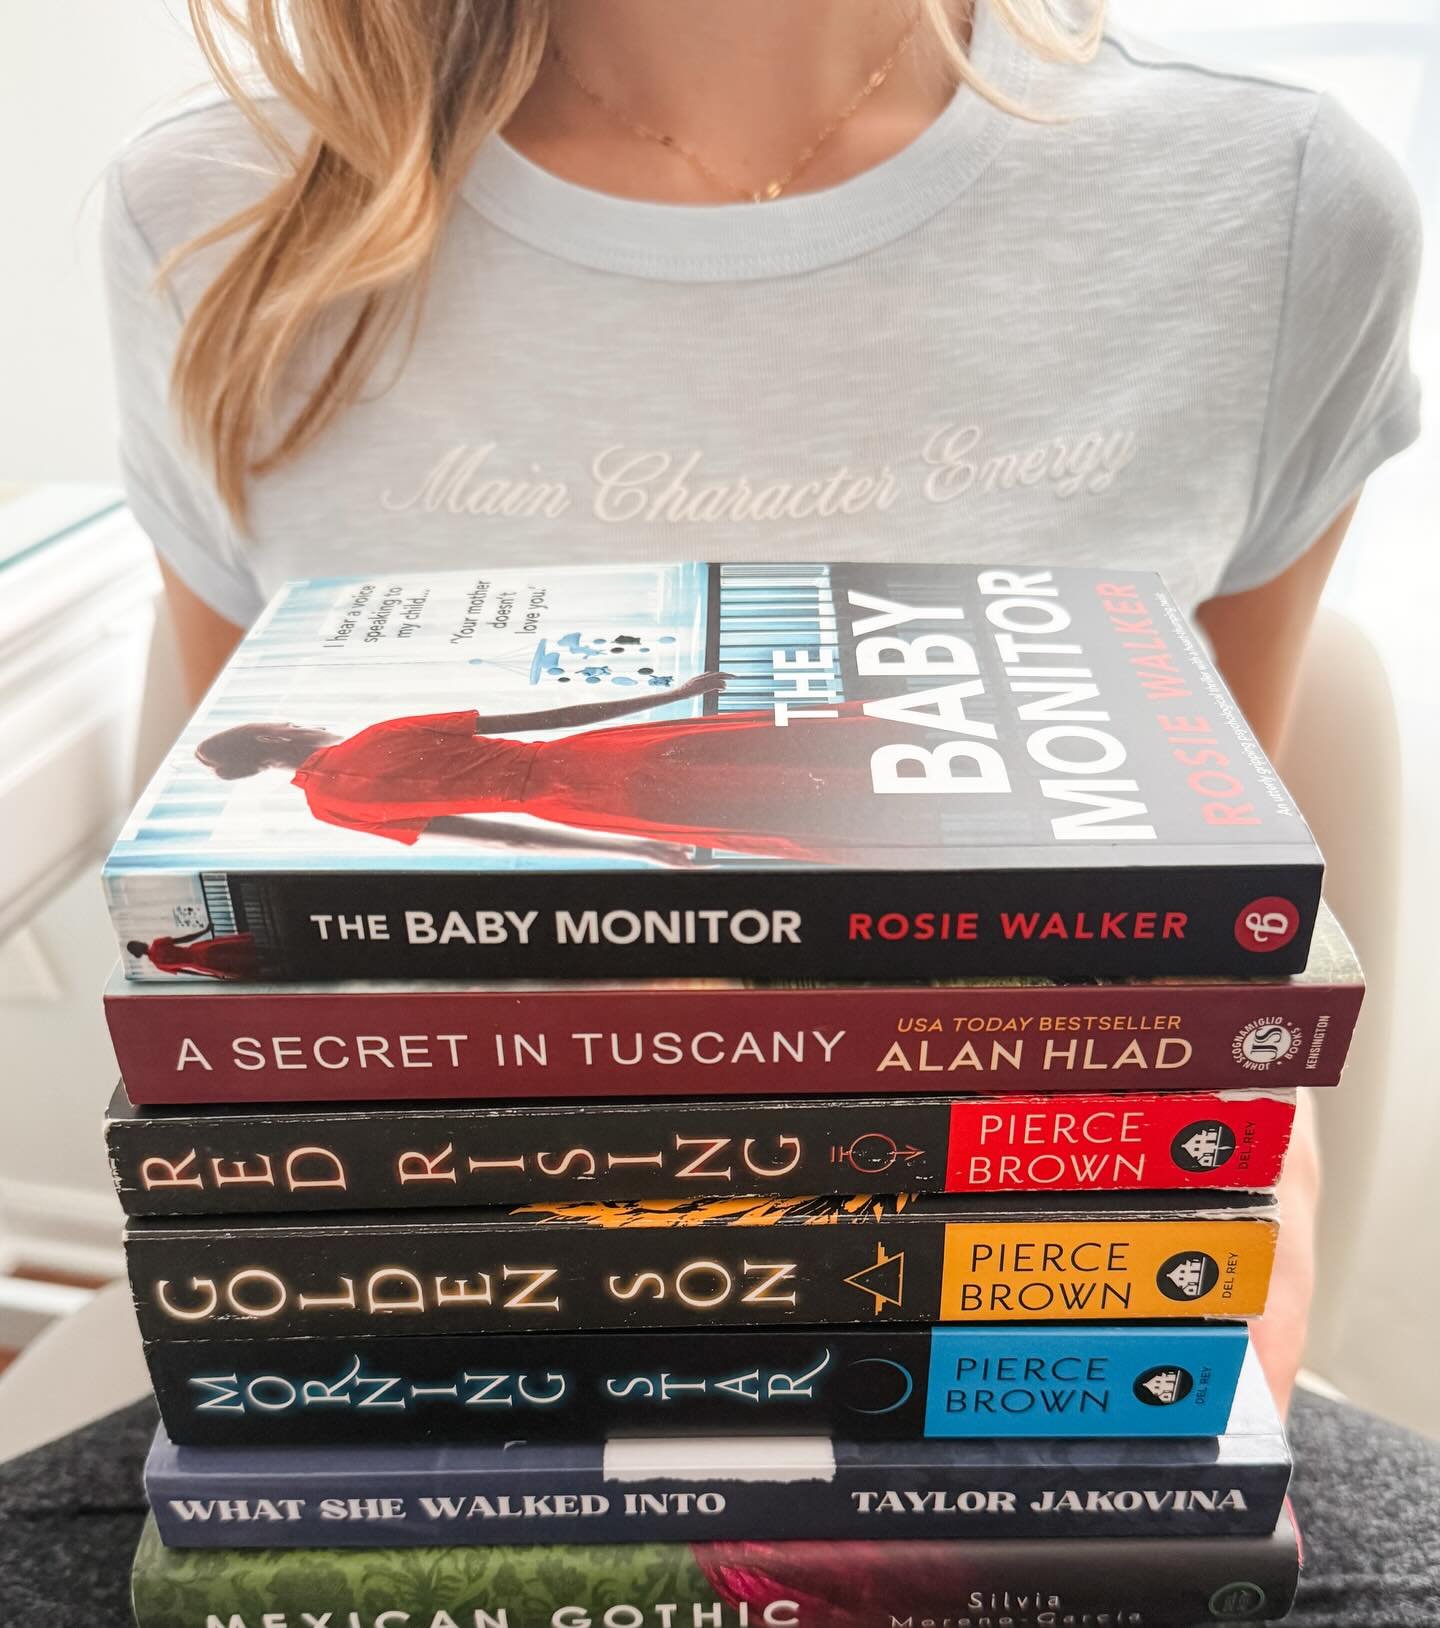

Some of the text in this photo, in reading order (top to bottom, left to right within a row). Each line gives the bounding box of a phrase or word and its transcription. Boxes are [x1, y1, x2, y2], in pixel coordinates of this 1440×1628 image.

[381, 423, 1137, 523] Main Character Energy
[326, 618, 355, 642] hear
[354, 584, 375, 609] voice
[364, 586, 402, 643] speaking to
[467, 580, 491, 616] mother
[397, 622, 421, 638] my
[515, 612, 539, 635] love
[773, 650, 839, 727] THE
[848, 590, 1012, 794] BABY
[977, 571, 1158, 840] MONITOR
[1095, 583, 1262, 827] ROSIE WALKER
[1276, 803, 1293, 816] An
[311, 910, 802, 945] THE BABY MONITOR
[848, 912, 1188, 940] ROSIE WALKER
[896, 1016, 1183, 1032] USA TODAY BESTSELLER
[176, 1030, 848, 1072] A SECRET IN TUSCANY
[876, 1038, 1194, 1072] ALAN HLAD
[1231, 1016, 1304, 1071] JOHN SCOGNAMIGLIO BOOKS
[1305, 1015, 1332, 1070] KENSINGTON
[980, 1112, 1146, 1145] PIERCE
[1238, 1120, 1256, 1170] DEL REY
[145, 1134, 802, 1192] RED RISING
[968, 1153, 1147, 1185] BROWN
[970, 1242, 1130, 1272] PIERCE
[159, 1259, 797, 1320] GOLDEN SON
[1221, 1251, 1239, 1299] DEL REY
[960, 1282, 1132, 1312] BROWN
[190, 1347, 831, 1415] MORNING STAR
[956, 1357, 1109, 1382] PIERCE
[945, 1388, 1110, 1413] BROWN
[168, 1492, 727, 1522] WHAT SHE WALKED INTO
[851, 1489, 1248, 1513] TAYLOR JAKOVINA
[551, 1600, 800, 1628] GOTHIC
[967, 1591, 1061, 1609] Silvia
[888, 1611, 1144, 1628] Moreno-Garcia
